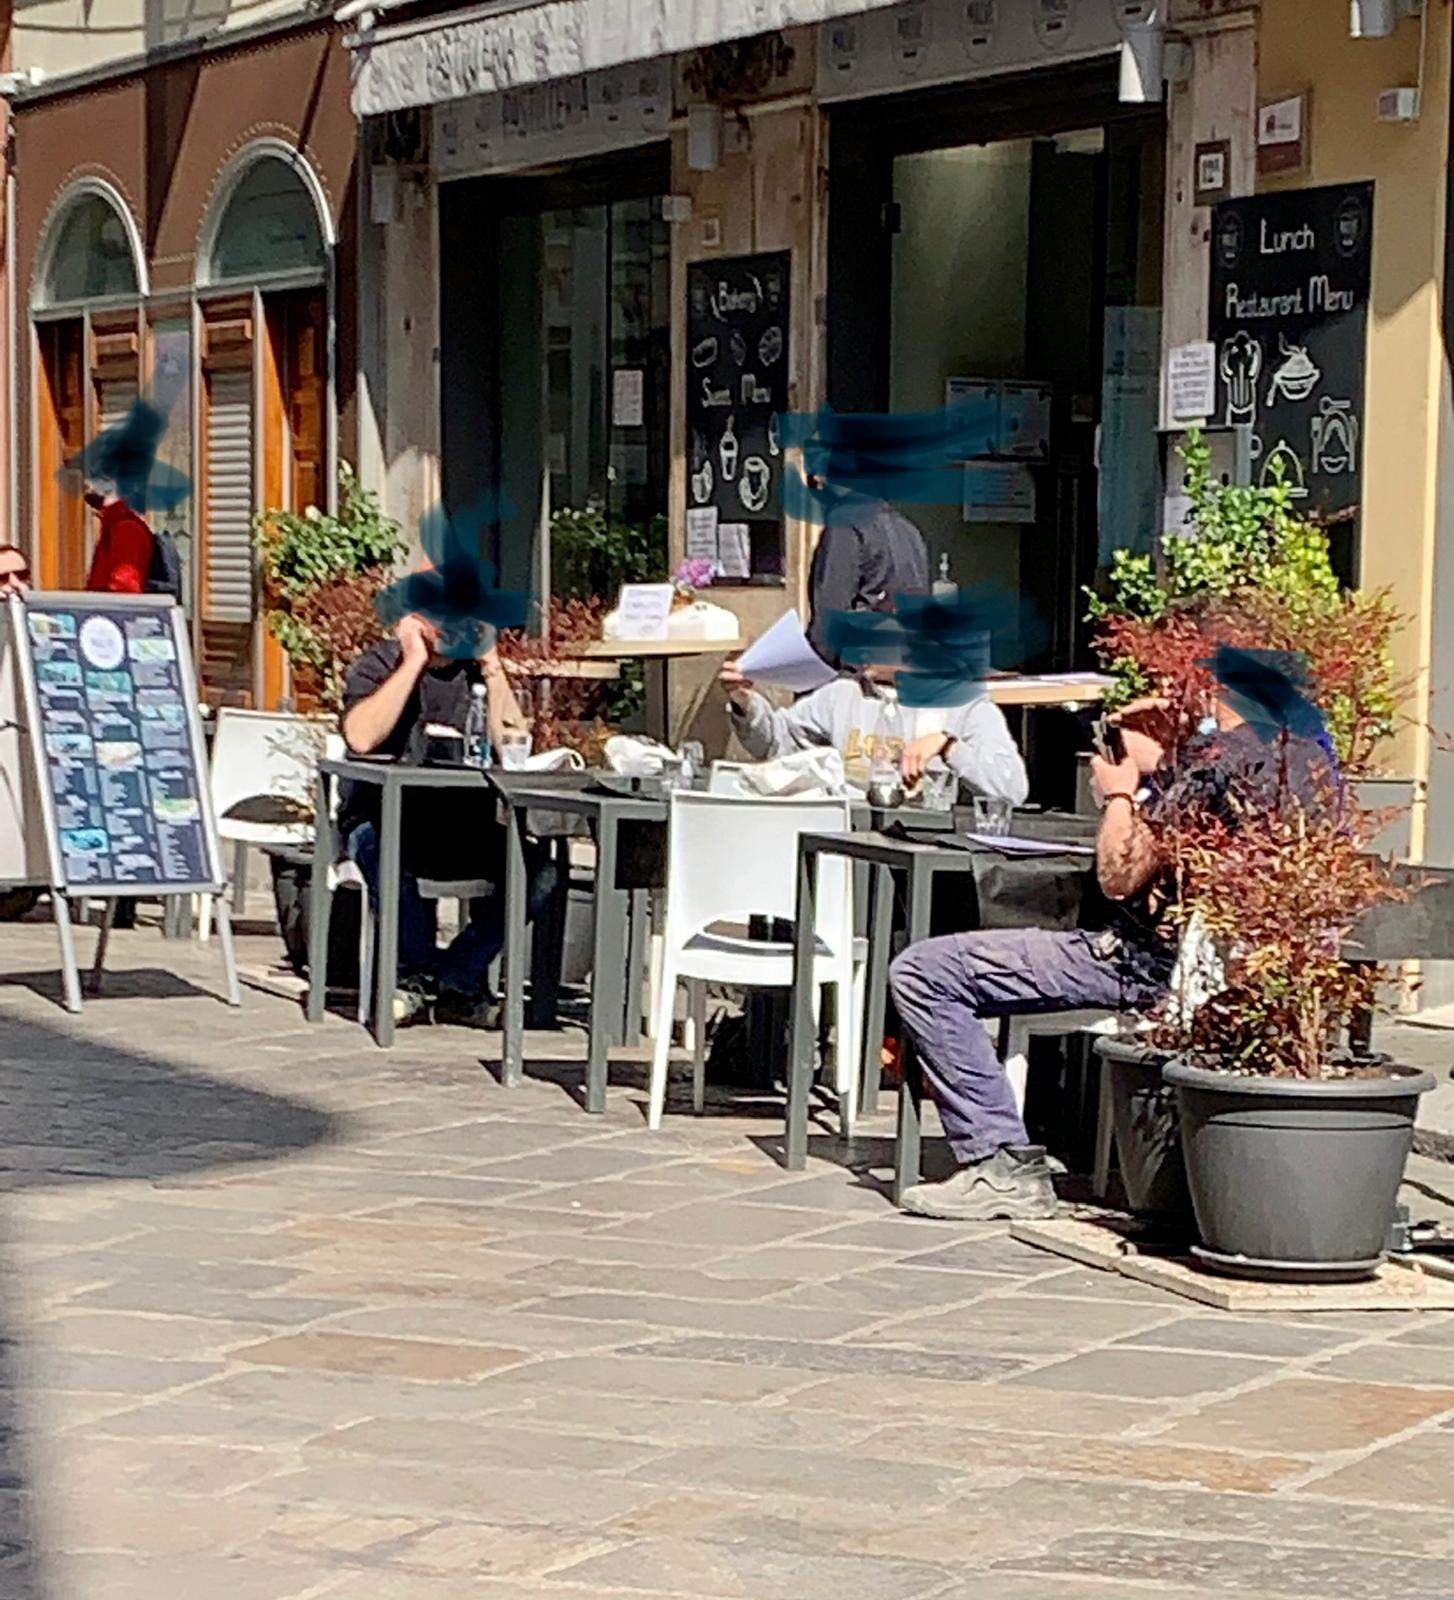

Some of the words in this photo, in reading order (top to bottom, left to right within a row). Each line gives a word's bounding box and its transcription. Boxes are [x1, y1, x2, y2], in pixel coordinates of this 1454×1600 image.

[1260, 218, 1315, 254] Lunch
[1225, 282, 1304, 319] Restaurant
[1308, 274, 1354, 313] Menu
